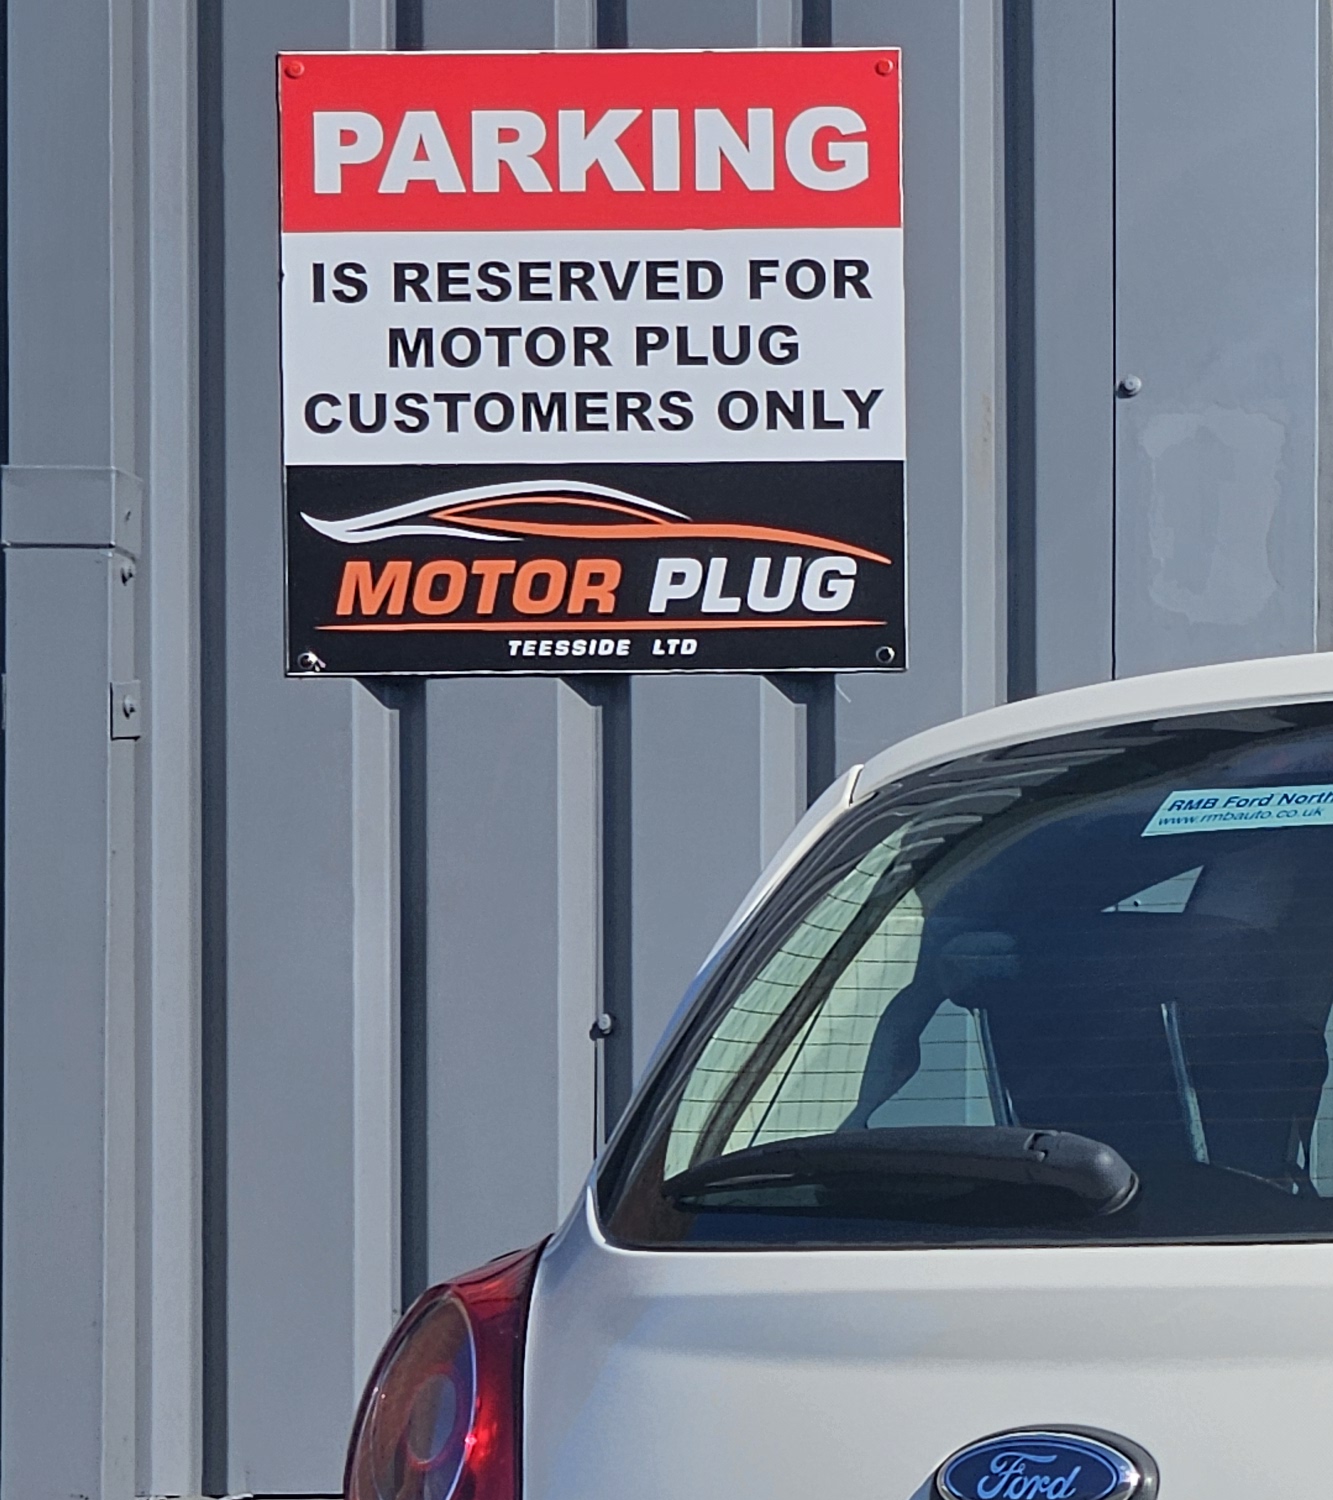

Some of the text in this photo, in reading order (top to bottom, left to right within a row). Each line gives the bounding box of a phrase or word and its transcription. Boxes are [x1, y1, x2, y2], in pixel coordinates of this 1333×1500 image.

[312, 105, 870, 194] PARKING
[311, 258, 872, 304] IS RESERVED FOR
[388, 324, 801, 369] MOTOR PLUG
[303, 388, 885, 435] CUSTOMERS ONLY
[335, 555, 858, 616] MOTOR PLUG
[508, 637, 698, 658] TEESSIDE LTD
[1158, 807, 1324, 826] www.rmbauto.co.uk
[1168, 797, 1219, 812] RMB
[1223, 793, 1274, 808] Ford
[976, 1451, 1083, 1500] Ford
